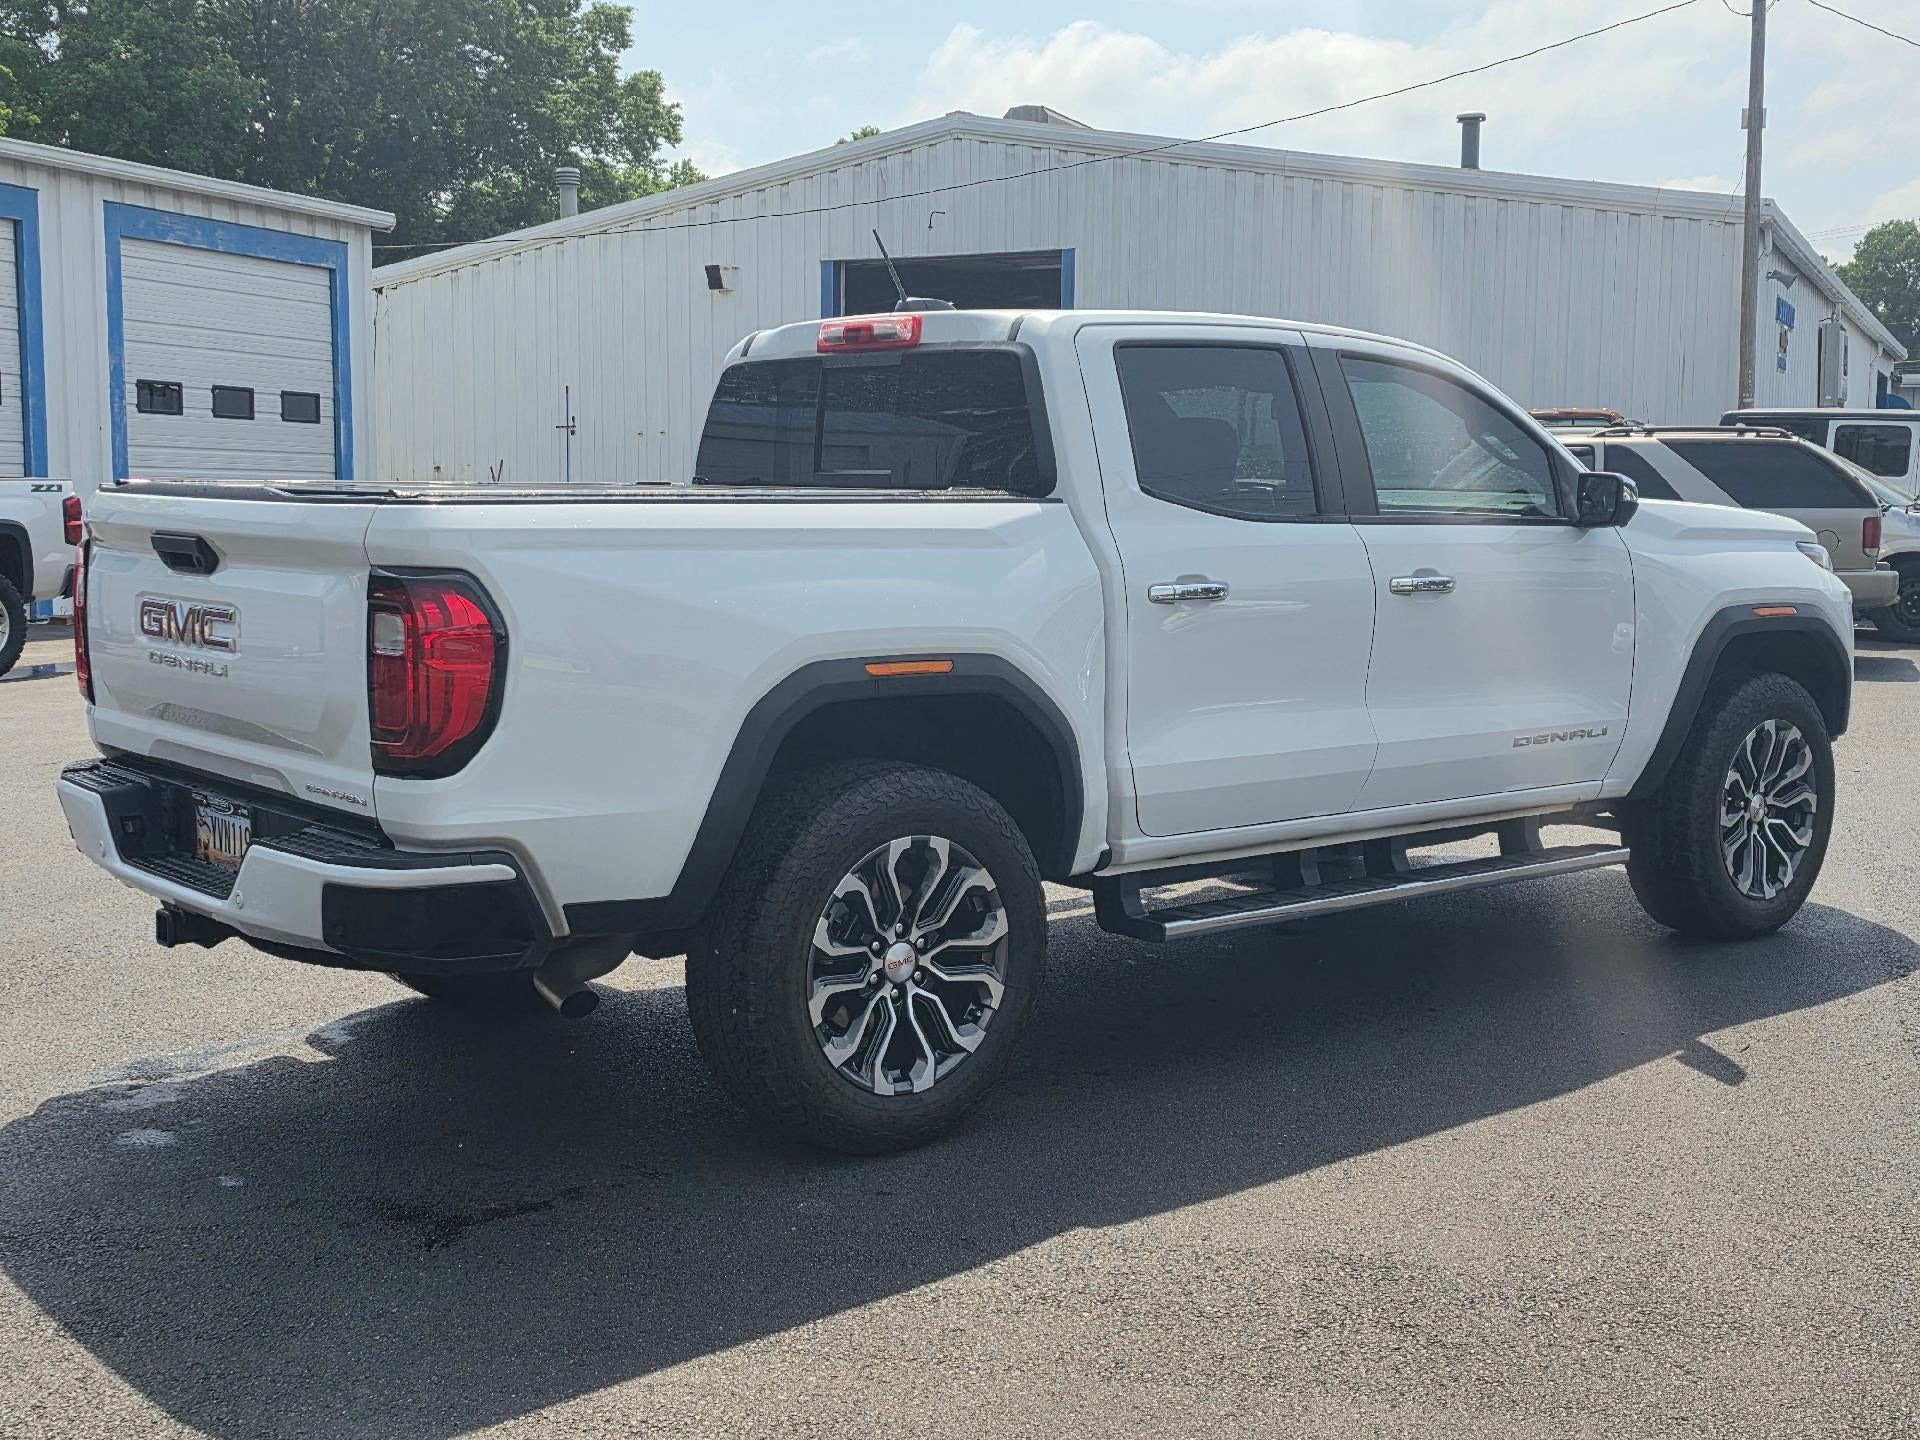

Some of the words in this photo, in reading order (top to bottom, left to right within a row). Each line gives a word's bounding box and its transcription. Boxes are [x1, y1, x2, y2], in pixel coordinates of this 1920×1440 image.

[140, 598, 236, 653] GMC
[148, 649, 228, 678] DENALI
[1512, 726, 1608, 748] DENALI
[887, 954, 914, 970] GMC
